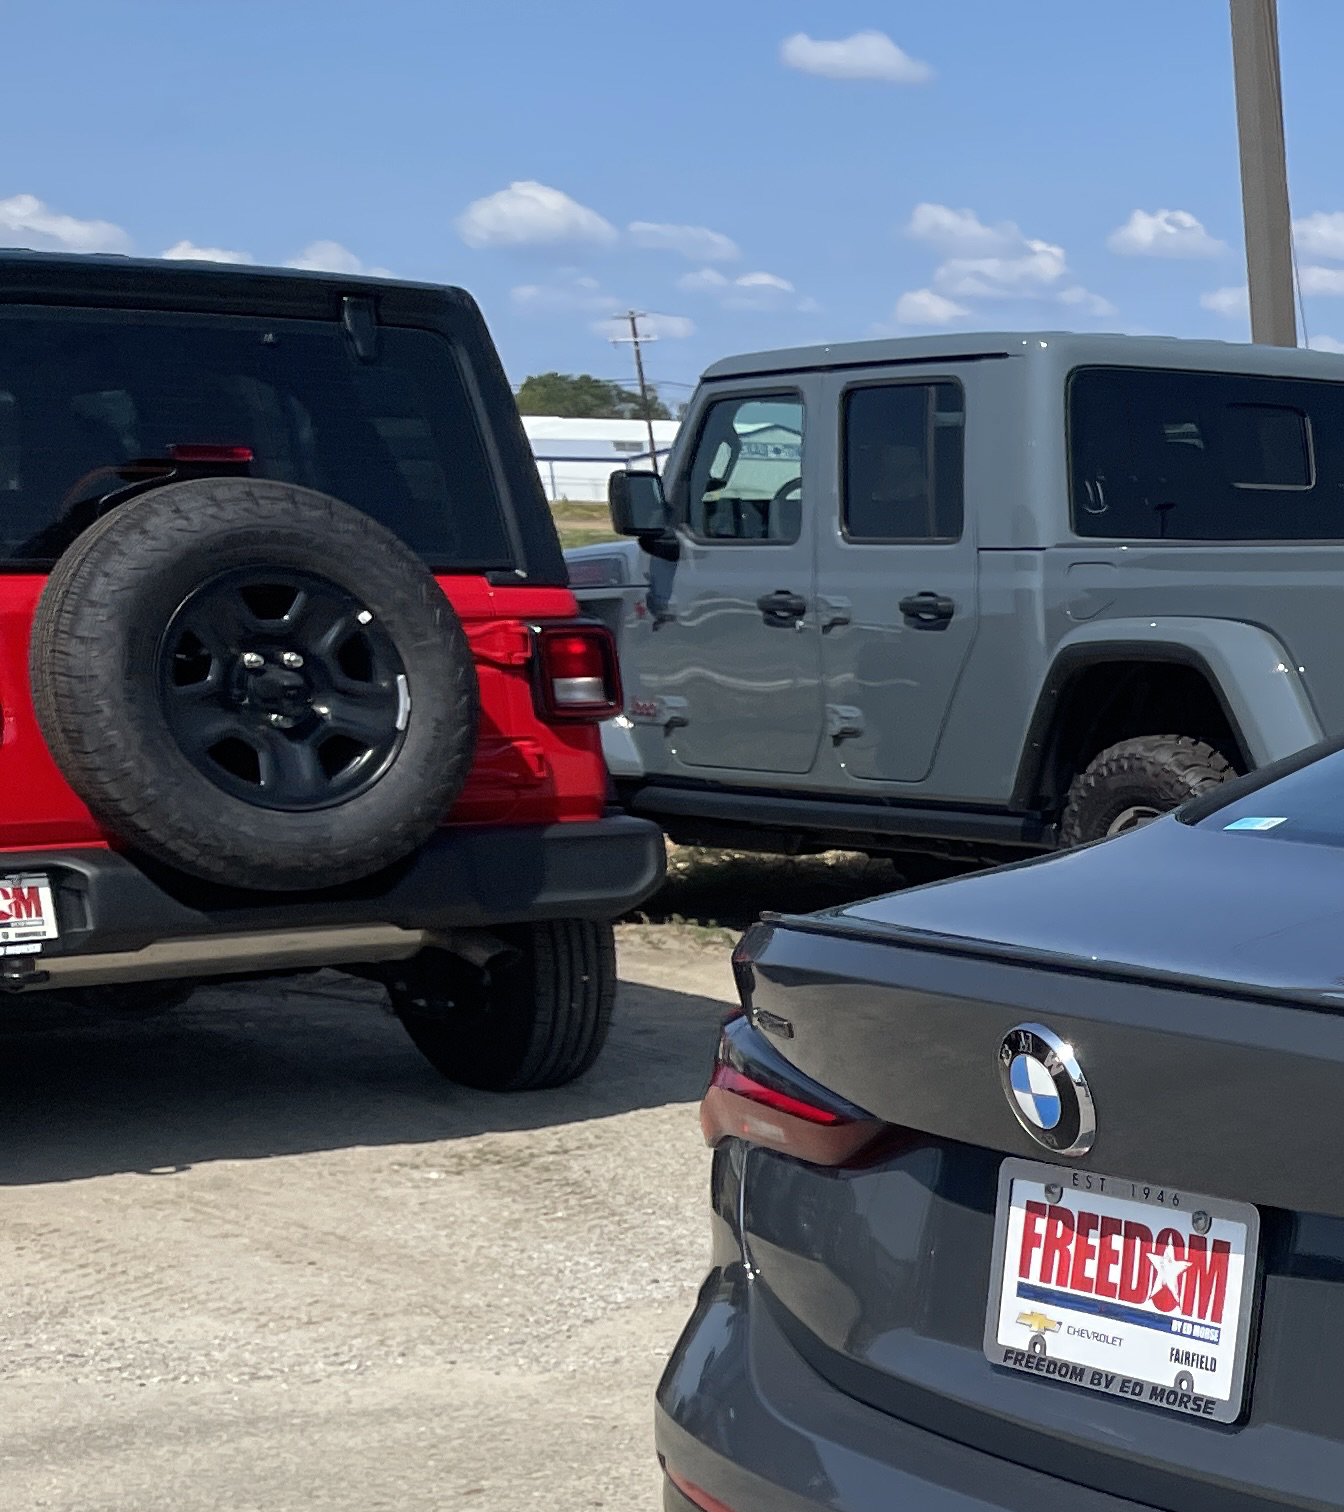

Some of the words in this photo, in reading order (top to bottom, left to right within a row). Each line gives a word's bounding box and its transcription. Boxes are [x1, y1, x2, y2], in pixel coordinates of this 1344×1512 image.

[1072, 1172, 1106, 1192] EST
[1131, 1183, 1180, 1207] 1946
[1018, 1200, 1232, 1325] FREEDOM
[1066, 1325, 1124, 1347] CHEVROLET
[1169, 1346, 1217, 1373] FAIRFIELD
[1003, 1348, 1085, 1383] FREEDOM
[1089, 1370, 1116, 1390] BY
[1119, 1379, 1145, 1398] ED
[1148, 1385, 1218, 1415] MORSE
